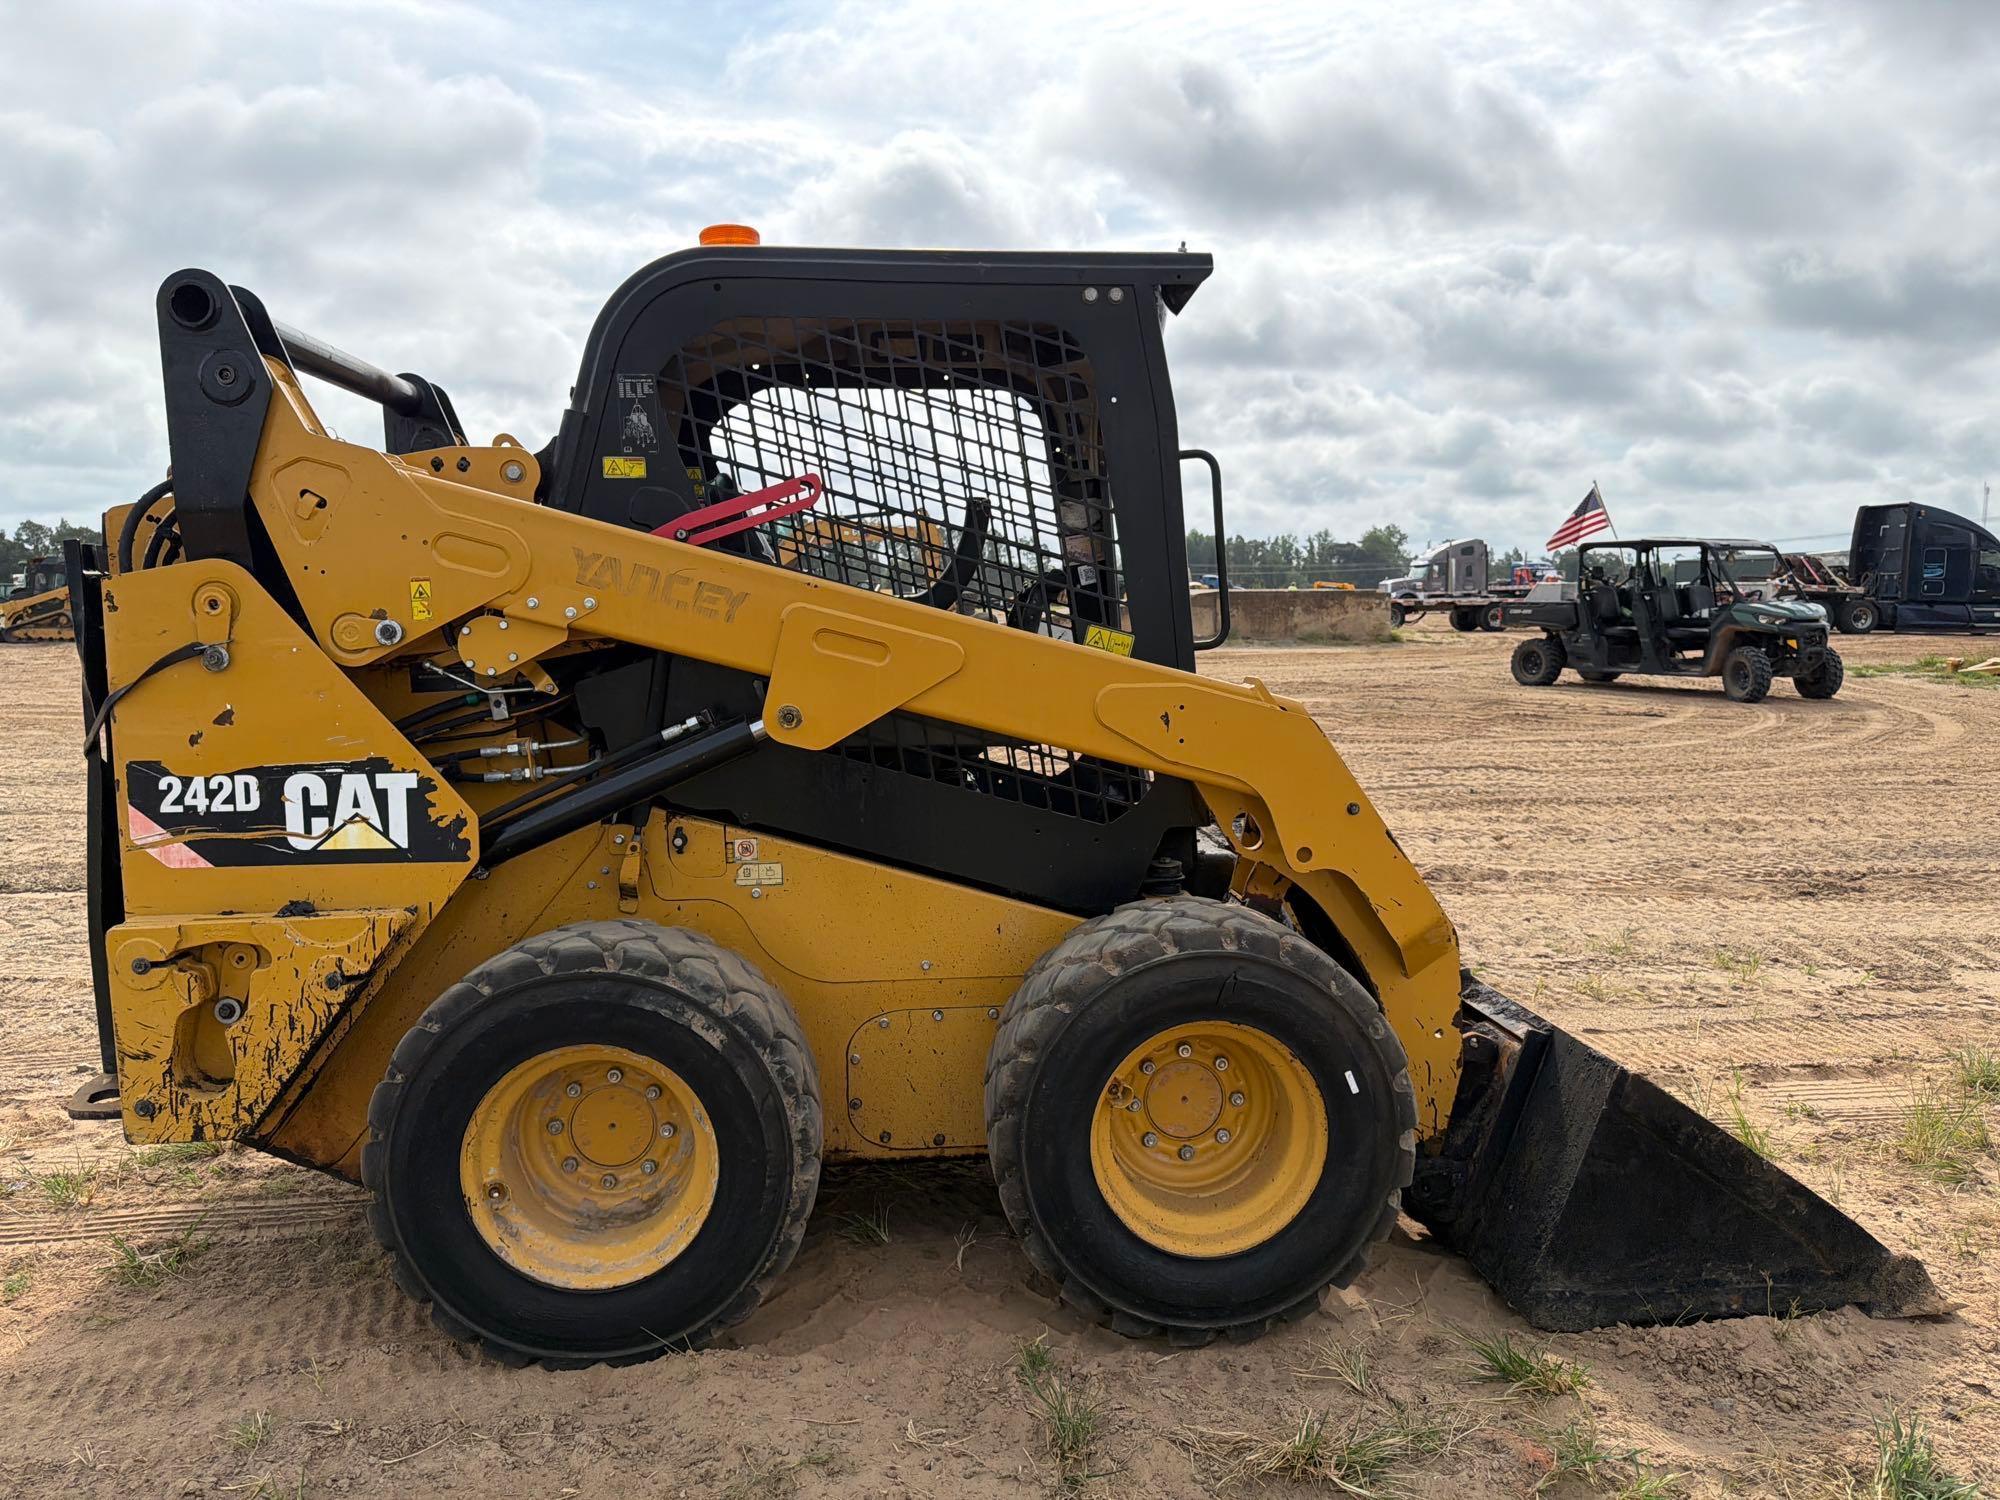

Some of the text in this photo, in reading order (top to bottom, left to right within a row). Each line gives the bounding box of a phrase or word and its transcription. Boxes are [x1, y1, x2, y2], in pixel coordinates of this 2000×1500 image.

[572, 546, 750, 624] YANCEY
[158, 773, 418, 850] 242D CAT
